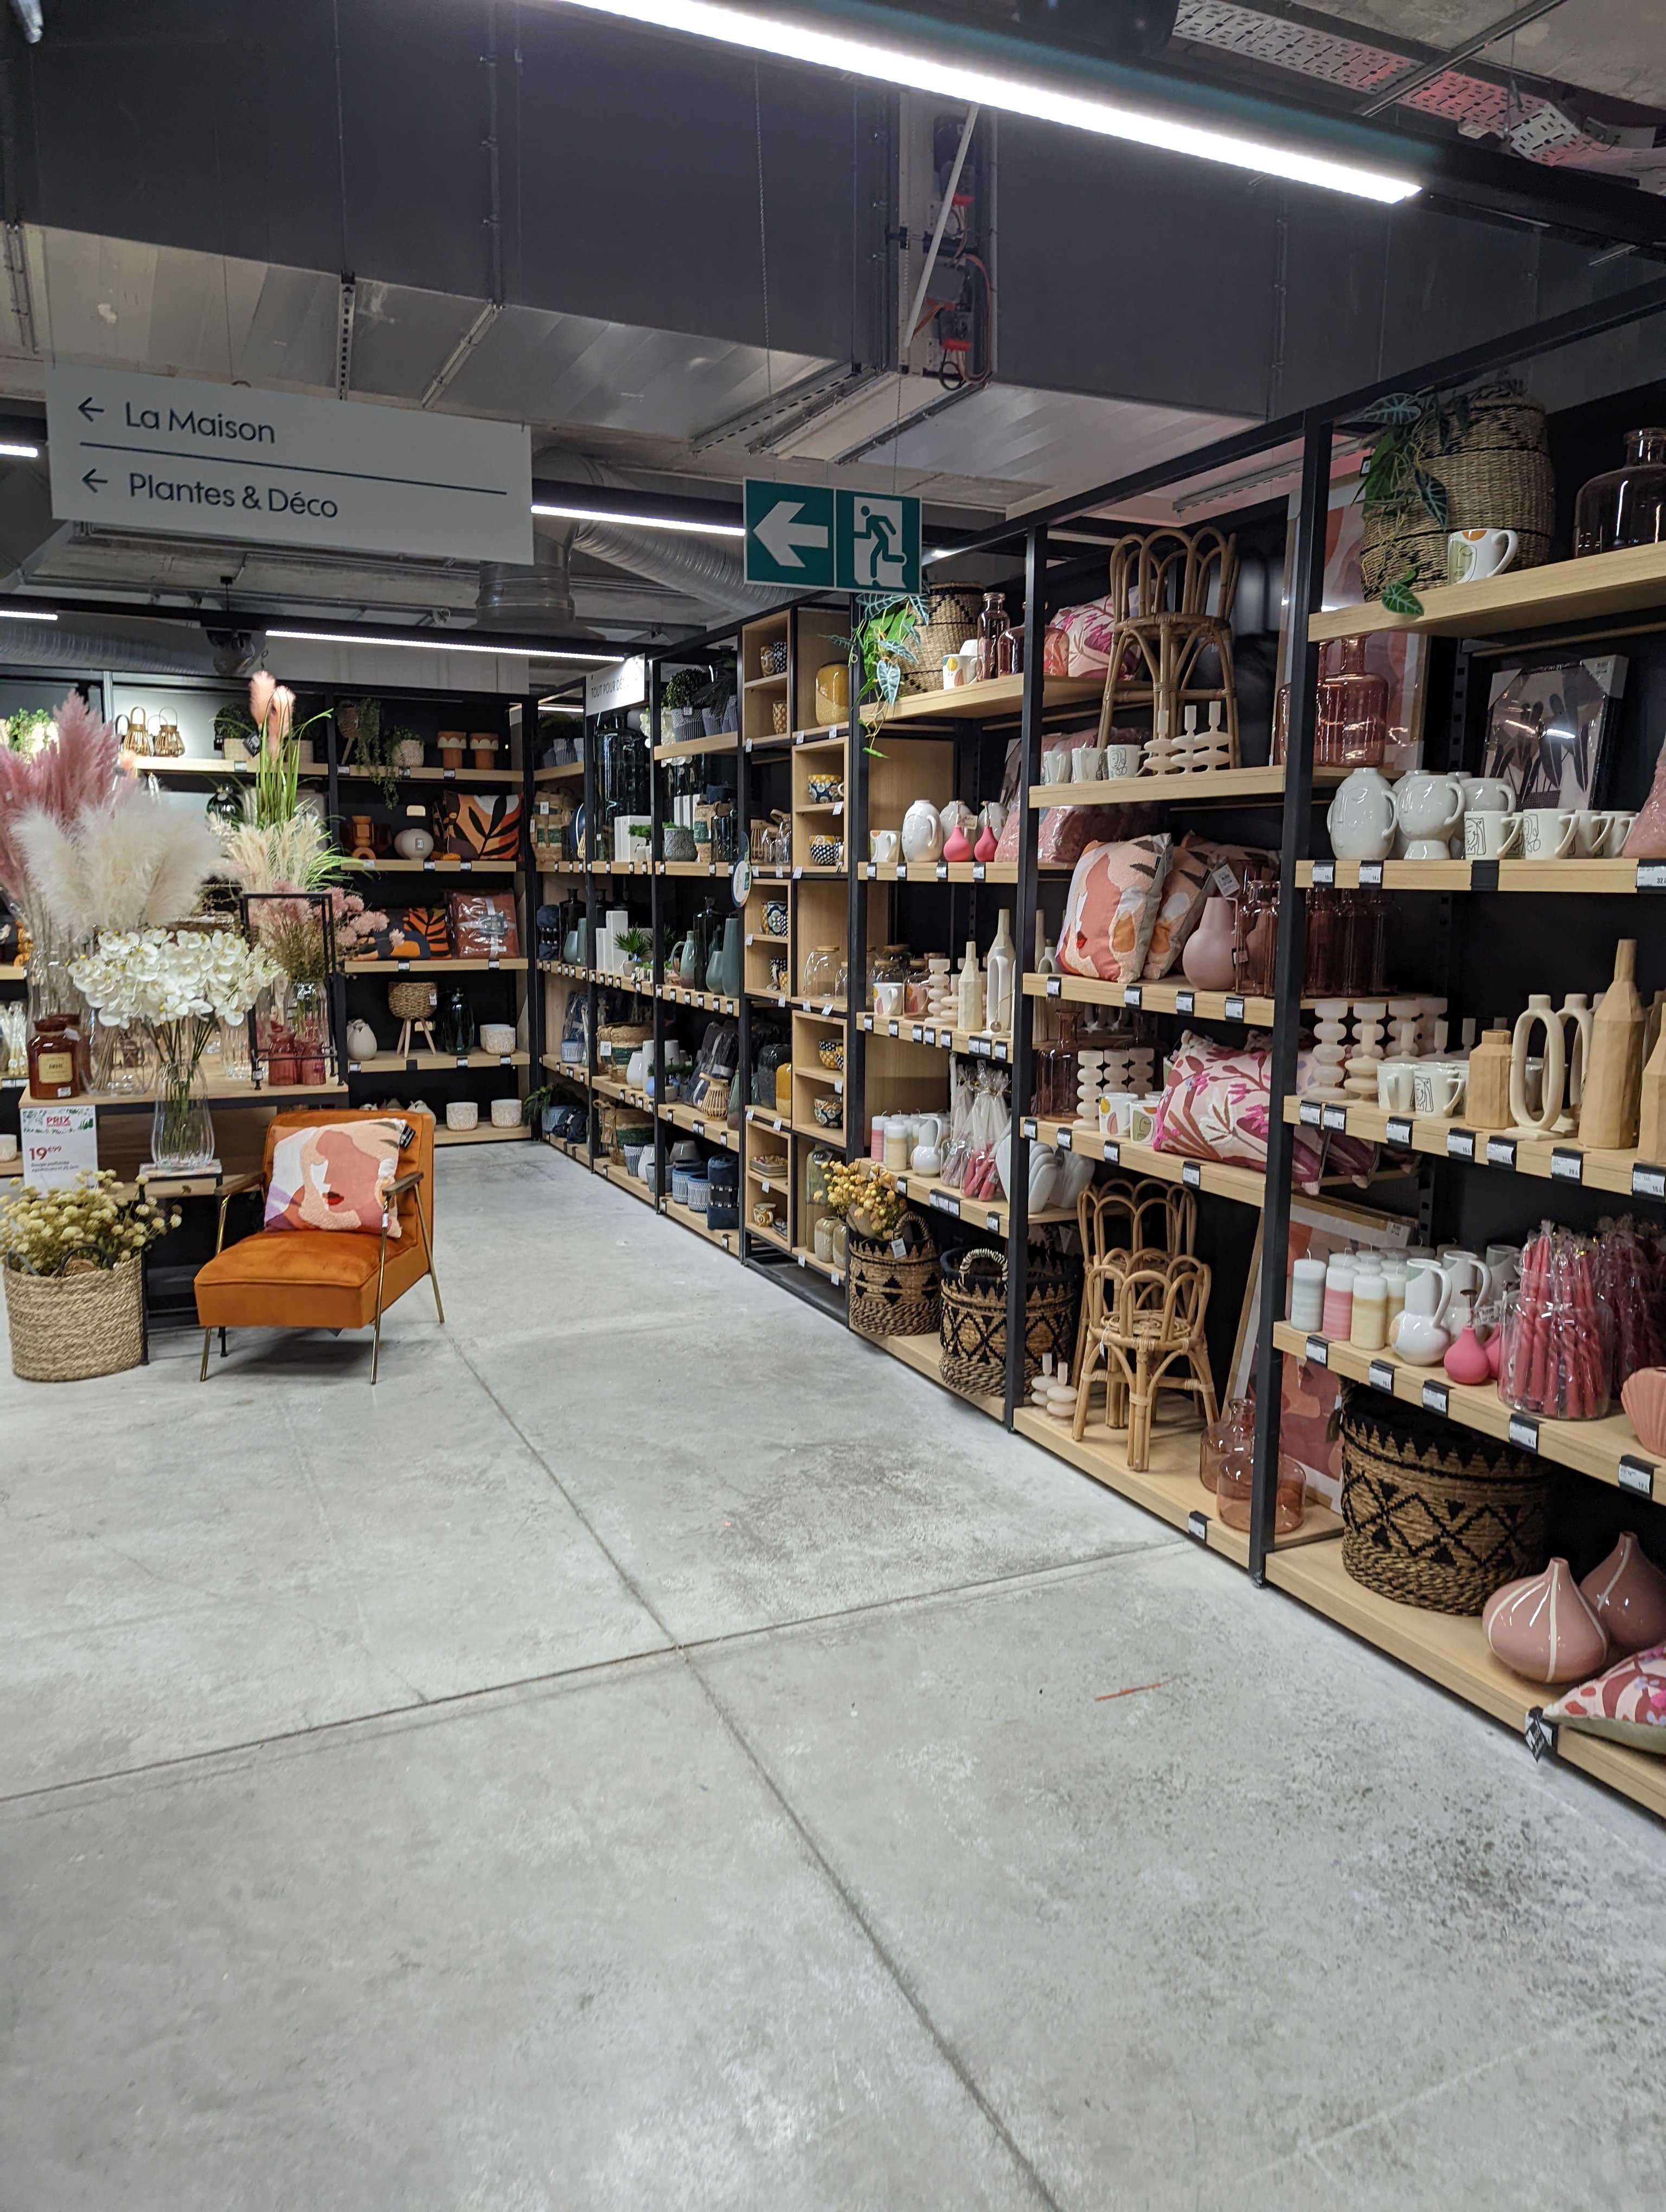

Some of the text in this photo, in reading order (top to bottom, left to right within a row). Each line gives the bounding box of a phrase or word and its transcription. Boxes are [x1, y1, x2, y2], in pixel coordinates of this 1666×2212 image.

[125, 401, 275, 444] La Maison
[129, 472, 338, 518] Plantes & Déco
[591, 684, 603, 699] TOUT
[603, 680, 616, 695] POUR
